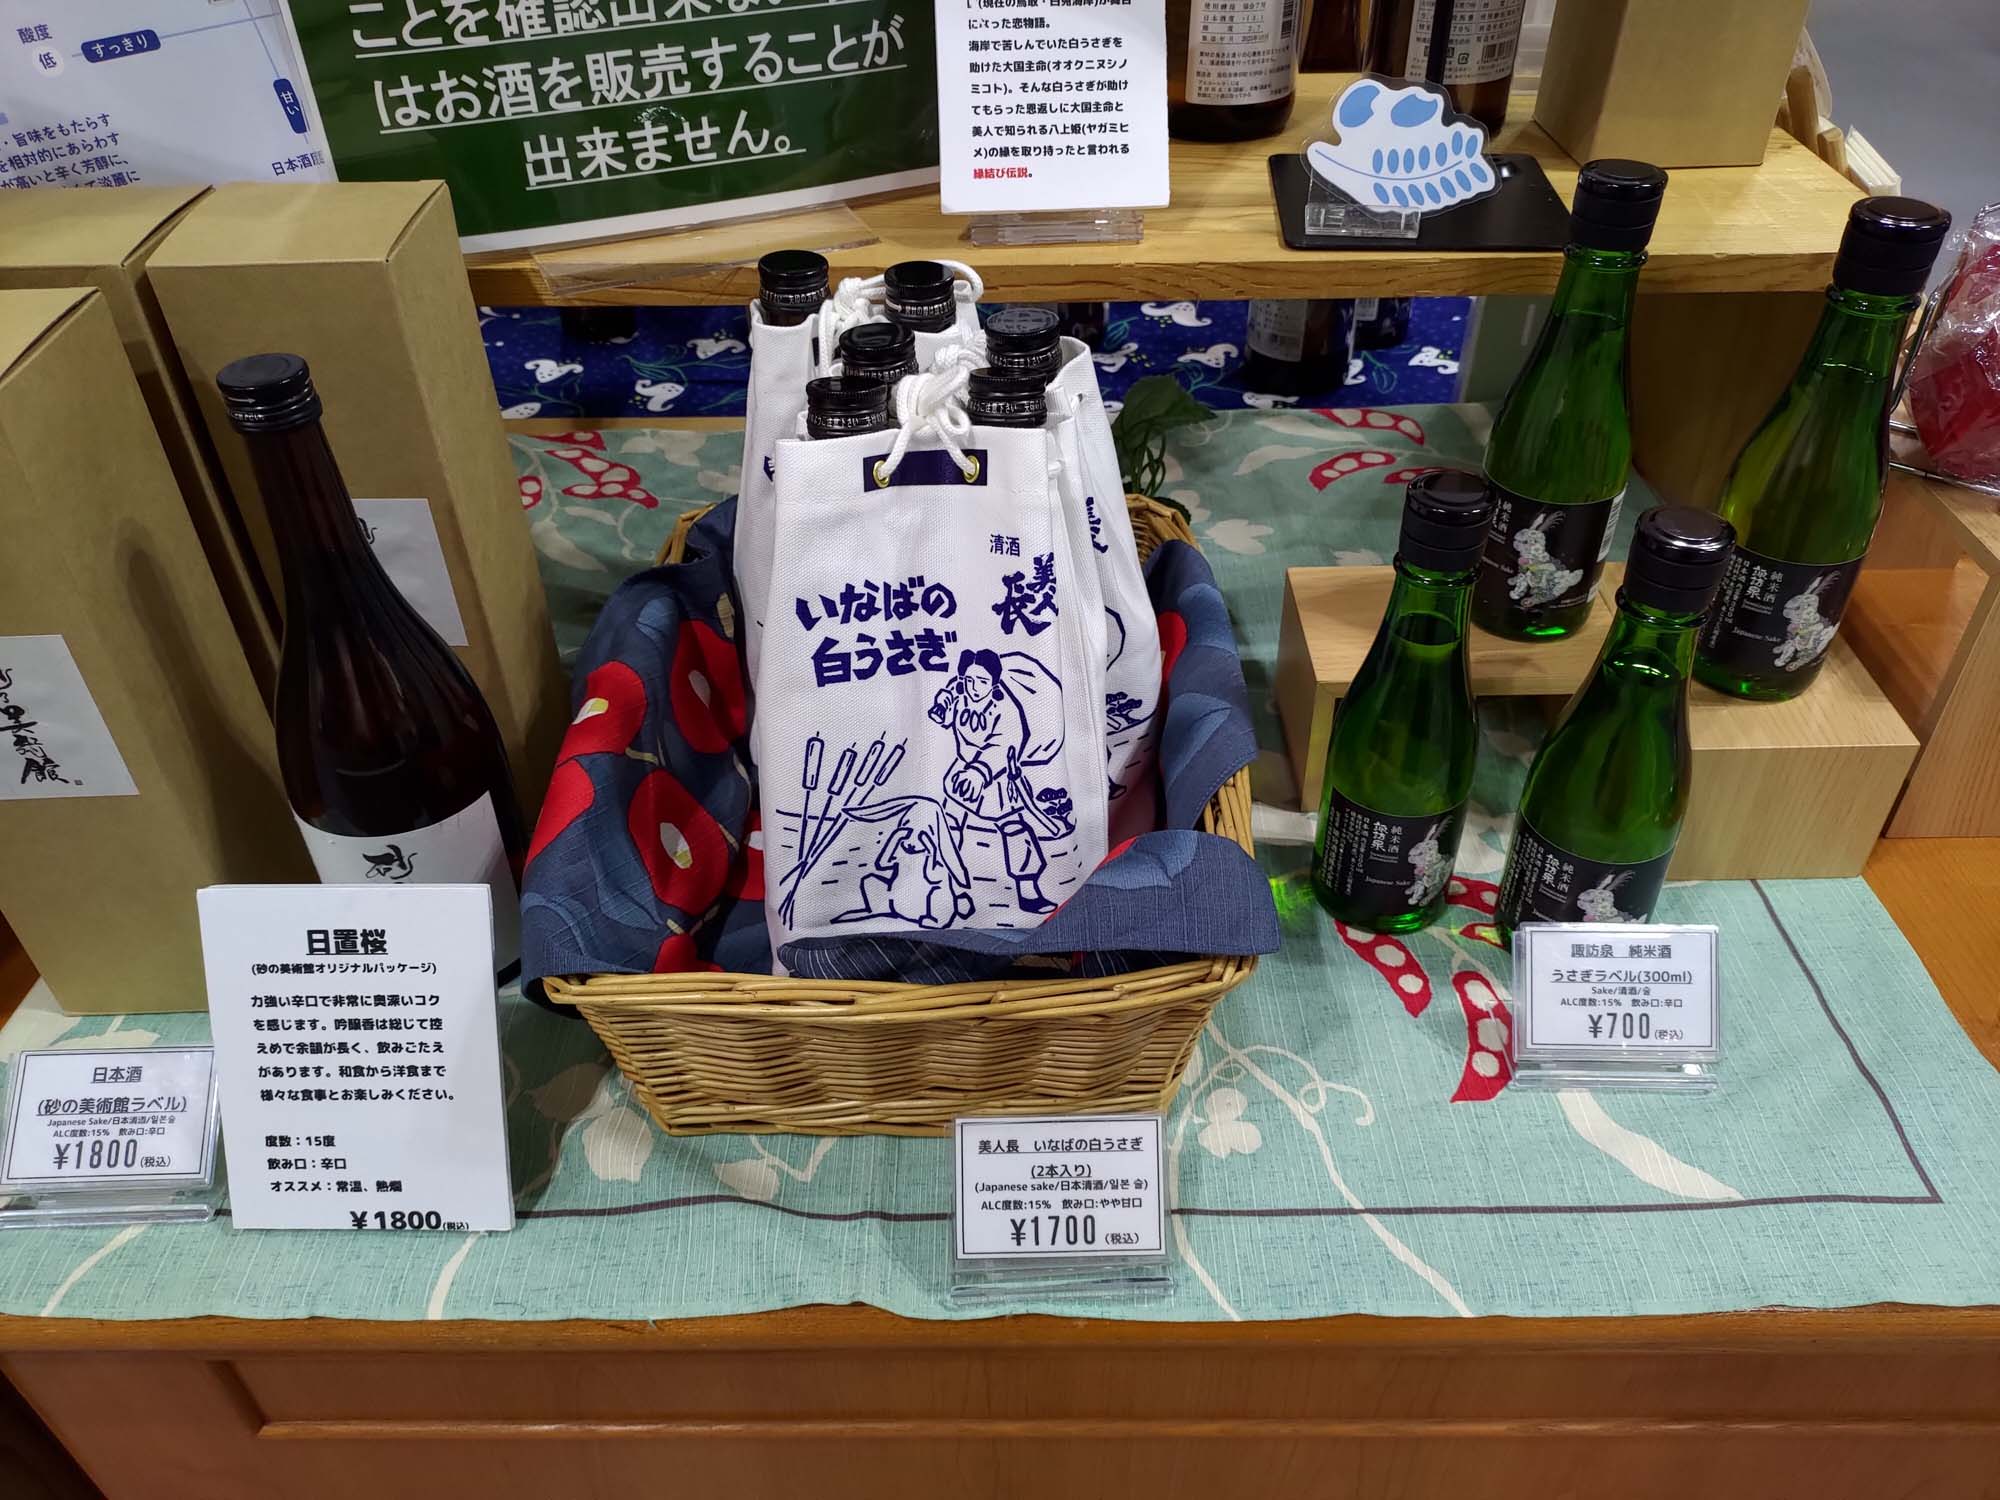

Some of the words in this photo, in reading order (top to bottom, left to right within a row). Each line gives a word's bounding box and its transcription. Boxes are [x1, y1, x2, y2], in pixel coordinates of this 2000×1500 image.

[17, 24, 52, 44] 酸度
[92, 35, 149, 58] すっきり
[968, 37, 1123, 52] 海岸で苦しんでいた白うさぎを
[39, 51, 57, 69] 低
[969, 59, 1128, 73] 助けた大国主命(オオクニヌシノ
[373, 14, 905, 127] はお酒を販売することが
[971, 80, 1129, 95] ミコト)。そんな白うさぎが助け
[280, 90, 301, 116] 甘い
[971, 101, 1124, 115] てもらった恩返しに大国主命と
[972, 122, 1129, 137] 美人で知られる八上姫(ヤガミヒ
[524, 109, 791, 186] 出来ません。
[973, 144, 1130, 158] メ)の縁を取り持ったと言われる
[973, 167, 1033, 179] 縁結び伝説。
[989, 534, 1021, 557] 清酒
[796, 575, 957, 631] いなばの
[811, 628, 957, 687] 白うさぎ
[307, 929, 387, 954] 日置桜
[1571, 943, 1614, 958] 諏訪泉
[1629, 944, 1672, 959] 純米酒
[252, 963, 437, 976] (砂の美術館オリジナルパッケージ)
[1552, 969, 1692, 983] うさぎラベル(300ml)
[251, 995, 440, 1008] 力強い辛口で非常に奥深いコク
[1560, 998, 1622, 1007] ALC度数:15%
[254, 1018, 443, 1031] を感じます。吟醸香は総じて控
[1588, 1013, 1650, 1039] ¥700
[257, 1042, 444, 1054] えめで余韻が長く、飲みごたえ
[93, 1066, 143, 1082] 日本酒
[258, 1065, 446, 1078] があります。和食から洋食まで
[260, 1089, 455, 1102] 様々な食事とお楽しみください。
[38, 1096, 187, 1114] (砂の美術館ラベル)
[48, 1118, 86, 1127] Japanese
[53, 1129, 110, 1137] ALC度数:15%
[119, 1127, 165, 1136] 飲み口:辛口
[265, 1135, 336, 1147] 度数：15度
[978, 1139, 1020, 1153] 美人長
[1034, 1137, 1143, 1151] いなばの白うさぎ
[54, 1139, 138, 1169] ¥1800
[268, 1158, 347, 1170] 飲み口：辛口
[1031, 1164, 1092, 1178] (2本入り)
[270, 1180, 402, 1192] オススメ：常温、熱燗
[975, 1182, 1028, 1193] (Japanese
[981, 1199, 1051, 1211] ALC度数:15%
[1062, 1197, 1143, 1209] 飲み口:やや甘口
[350, 1211, 441, 1230] ¥1800
[1010, 1214, 1096, 1246] ¥1700
